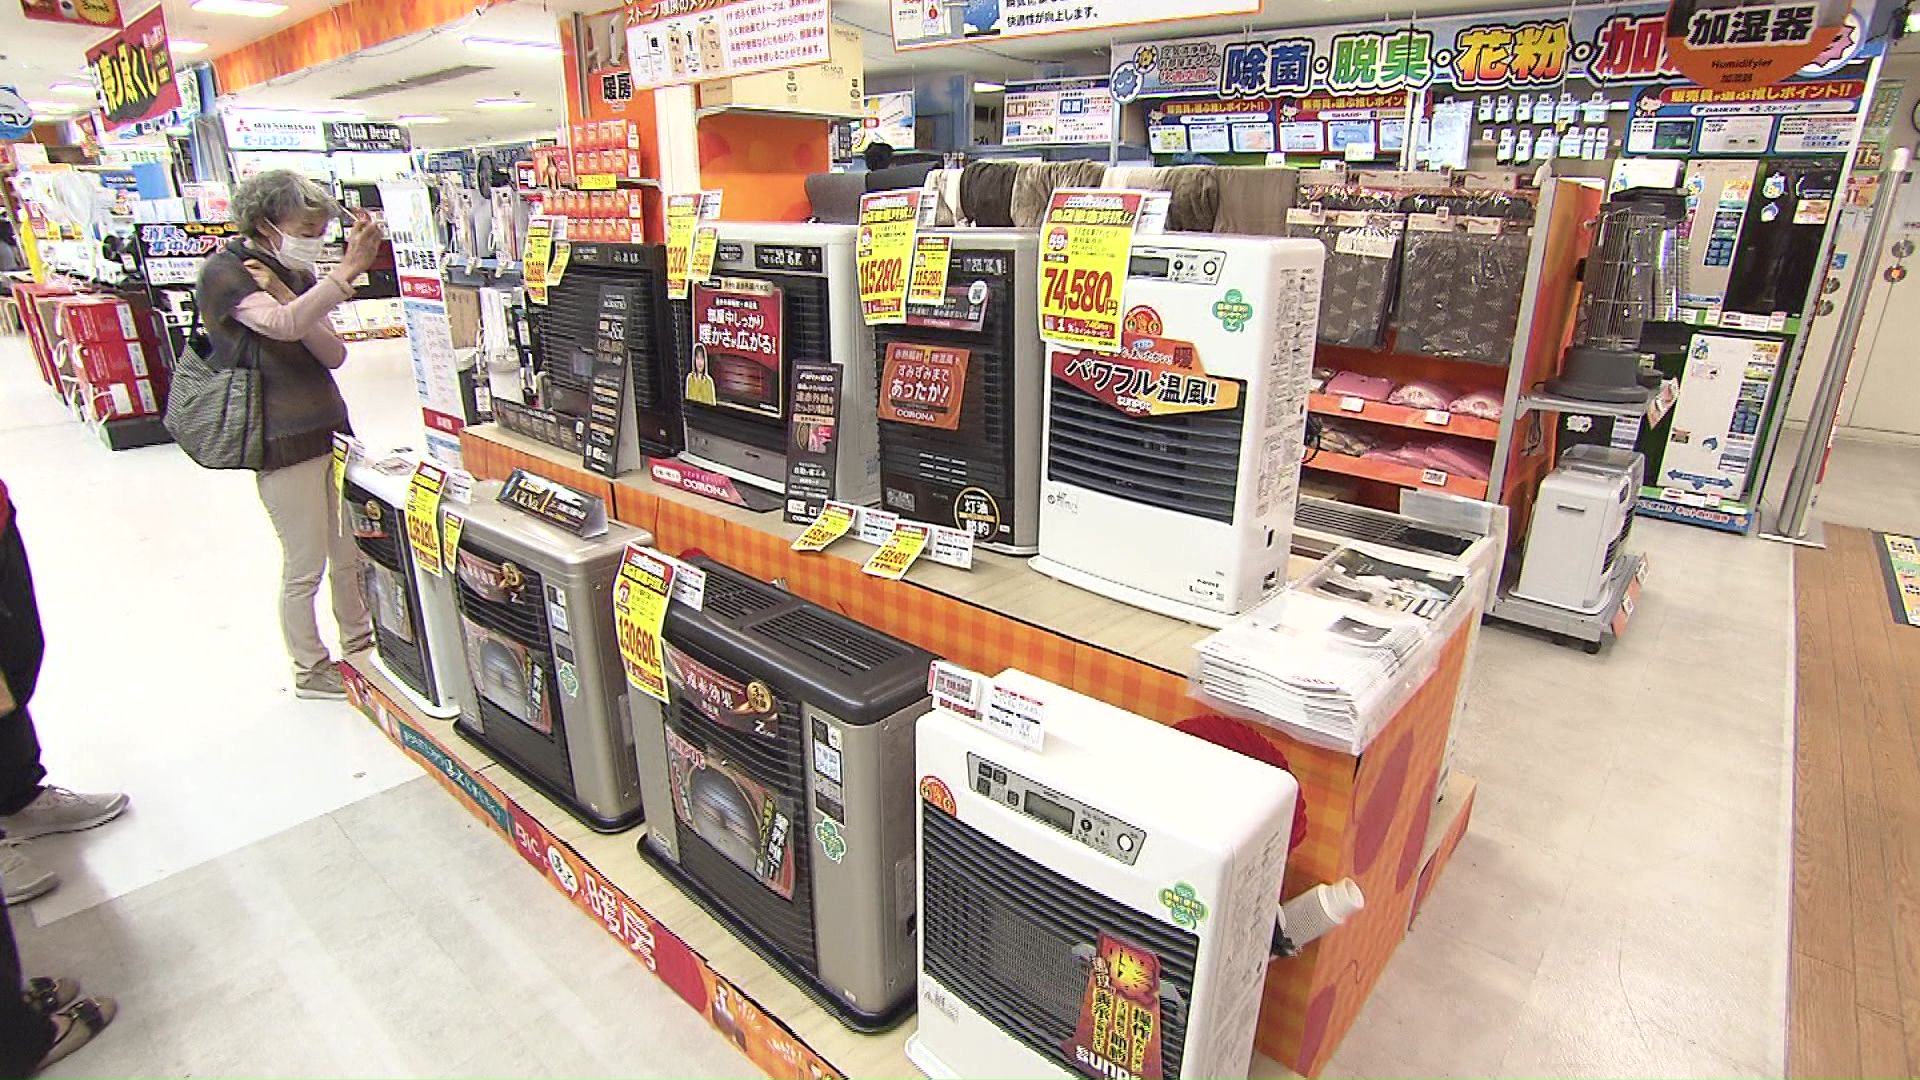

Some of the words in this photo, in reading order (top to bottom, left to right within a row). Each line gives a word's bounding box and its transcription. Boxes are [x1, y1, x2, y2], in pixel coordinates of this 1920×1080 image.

[1687, 5, 1814, 46] 加湿器
[603, 73, 632, 100] 暖房
[1044, 266, 1118, 316] 74,580円
[899, 365, 950, 381] すみずみまで
[1066, 359, 1218, 405] パワフル温風!
[891, 379, 950, 403] あったか!
[896, 408, 935, 421] CORONA
[683, 478, 729, 498] CORONA
